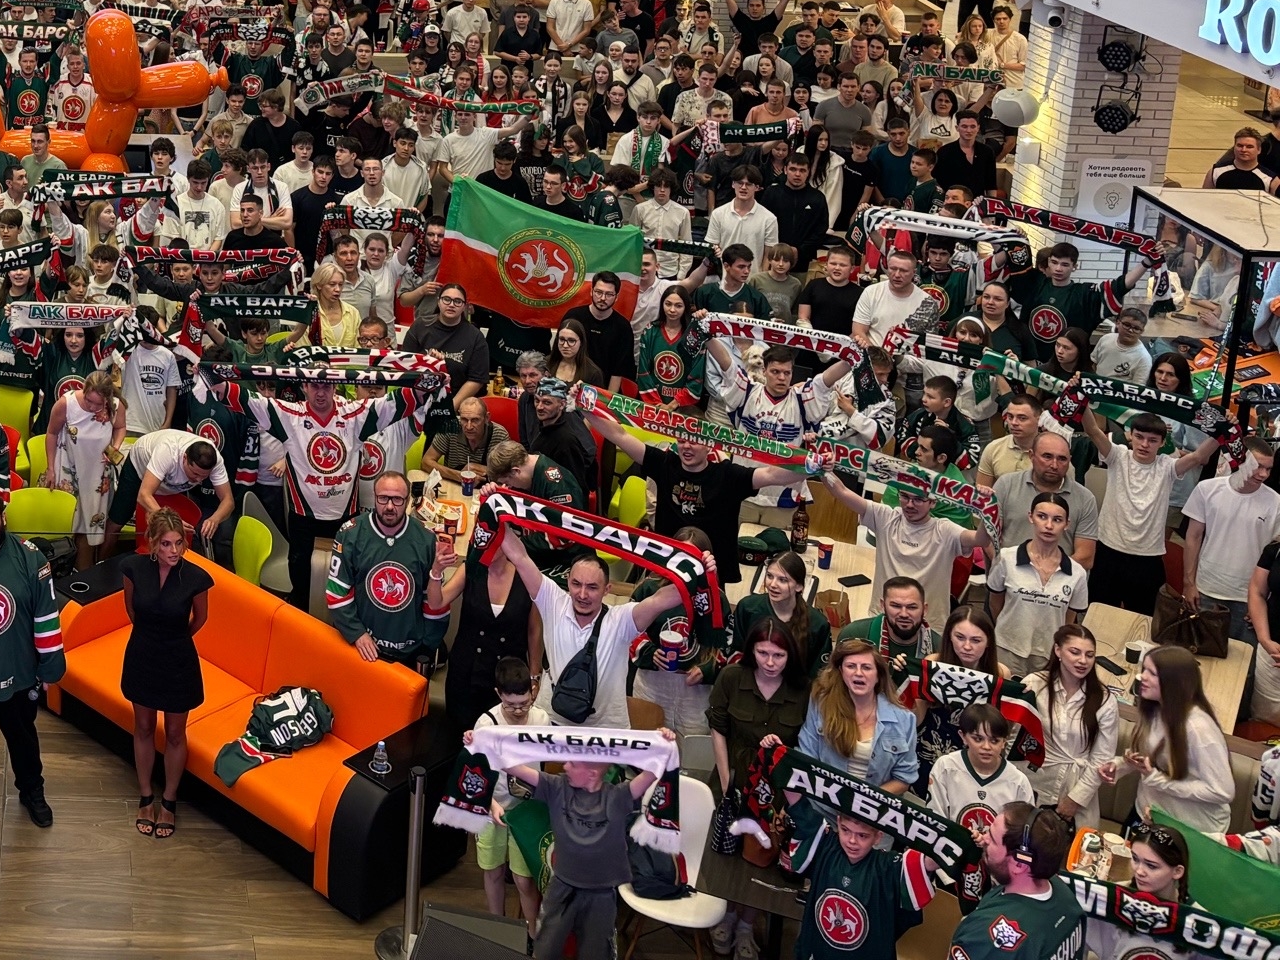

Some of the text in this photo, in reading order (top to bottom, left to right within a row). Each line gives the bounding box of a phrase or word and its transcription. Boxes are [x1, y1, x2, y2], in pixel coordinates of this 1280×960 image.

[22, 24, 68, 39] БАРС
[912, 62, 1005, 84] АК БАРС
[455, 100, 537, 115] БАРС
[724, 125, 783, 136] АК БАРС
[56, 174, 74, 182] АК
[1085, 172, 1146, 180] тебя еще больше
[1087, 164, 1146, 175] Хотим радовать
[72, 182, 117, 196] АК
[892, 214, 978, 234] АК БАРС
[985, 197, 1160, 260] АК БАРС
[136, 246, 297, 264] АК БАРС
[210, 295, 309, 309] AK BARS
[29, 307, 61, 320] АК
[235, 308, 282, 317] KAZAN
[736, 316, 836, 340] ХОККЕЙНЫЙ КЛУБ
[293, 345, 358, 359] BARS
[708, 320, 862, 367] АК БАРС
[938, 352, 965, 363] АК
[0, 370, 33, 380] TATNEFT
[250, 365, 405, 381] АК БАРС
[1080, 376, 1194, 411] АК БАРС
[1083, 386, 1147, 404] КАЗАНЬ
[608, 397, 794, 458] АК БАРС КАЗАНЬ
[643, 420, 753, 458] ХОККЕЙНЫЙ КЛУБ
[305, 473, 353, 485] АК БАРС
[485, 493, 705, 583] АК БАРС
[328, 554, 342, 578] 9
[518, 732, 651, 751] АК БАРС
[810, 764, 947, 833] ХОККЕЙНЫЙ КЛУБ
[786, 767, 963, 868] АК БАРС
